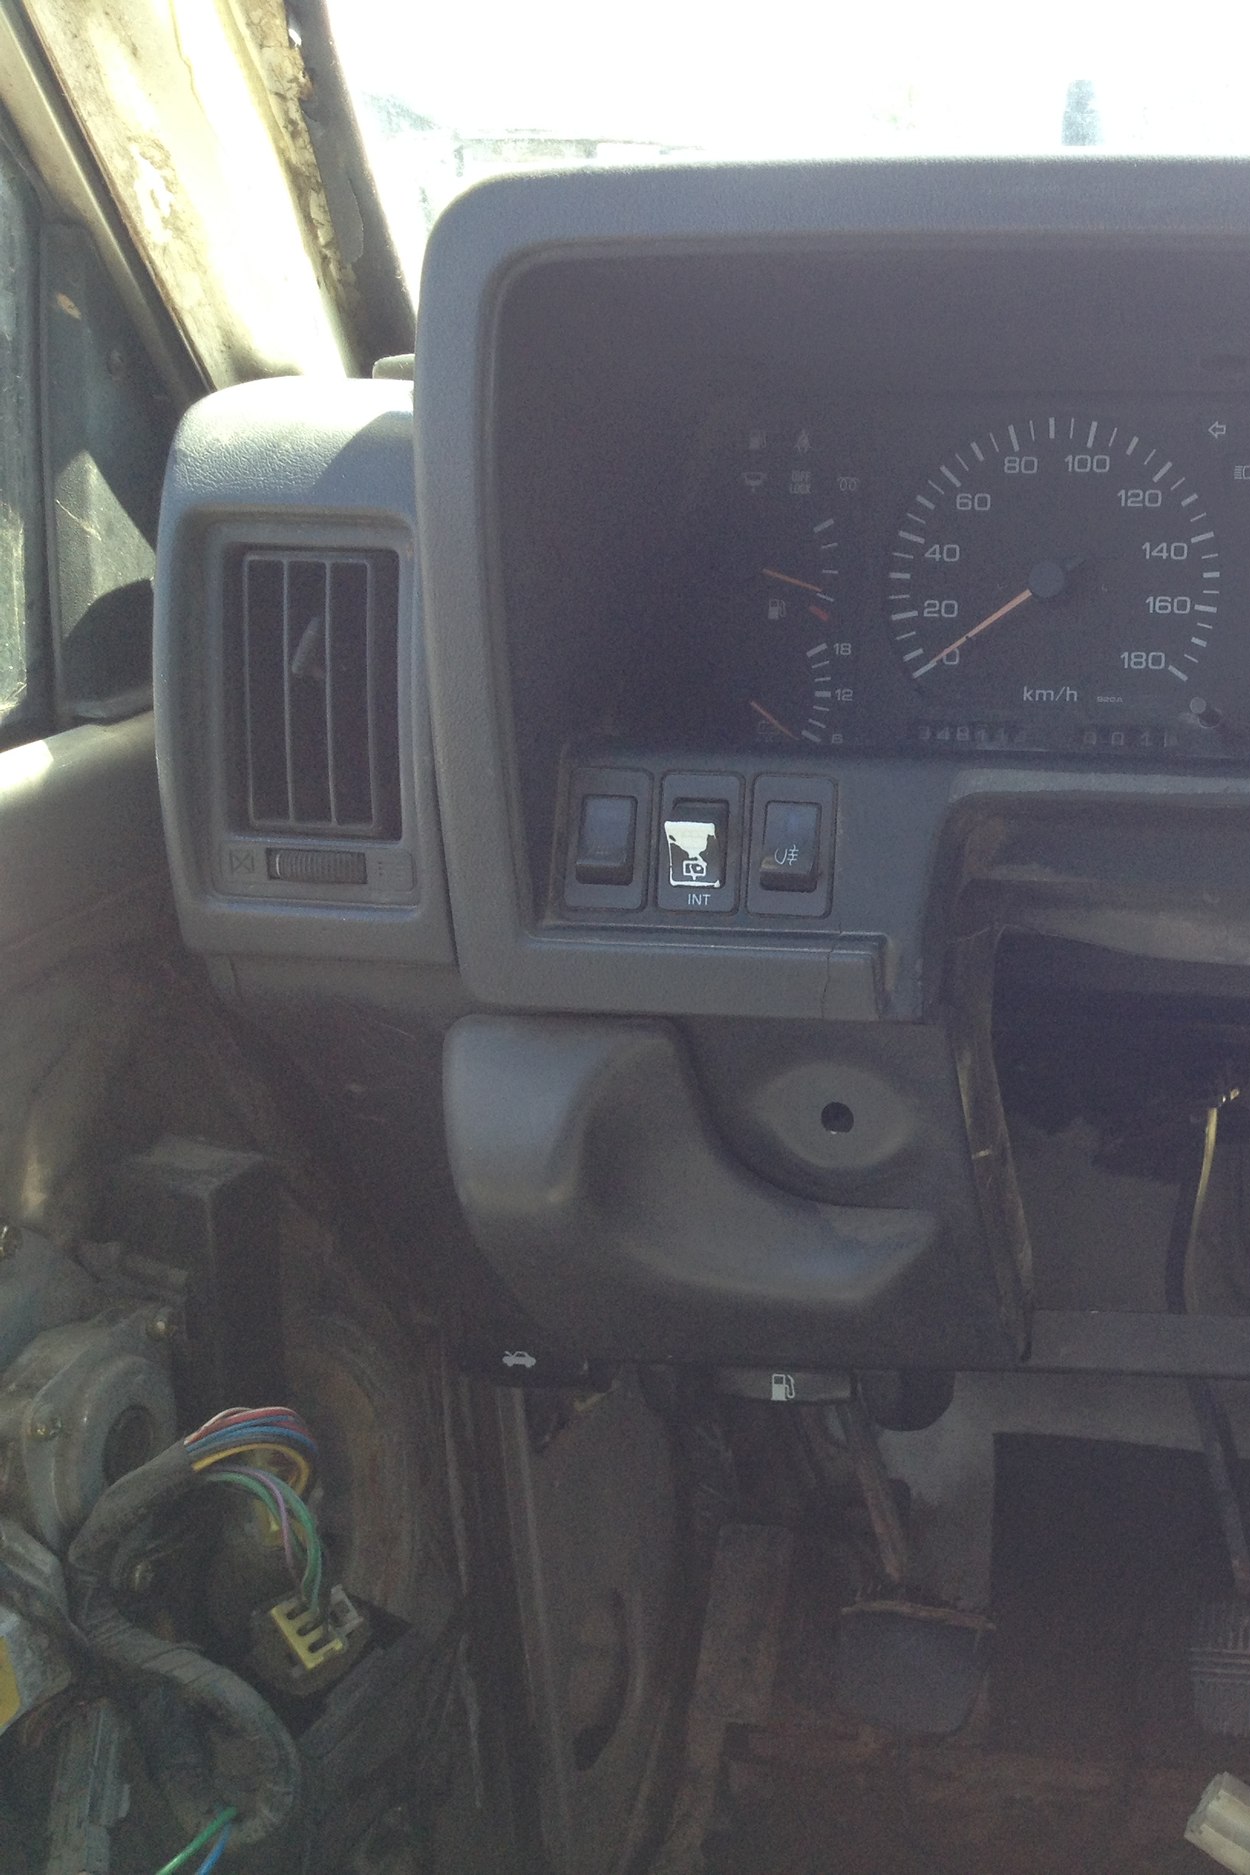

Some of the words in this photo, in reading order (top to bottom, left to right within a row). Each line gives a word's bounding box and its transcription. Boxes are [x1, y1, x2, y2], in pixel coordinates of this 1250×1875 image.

[1003, 455, 1038, 475] 80
[1064, 454, 1110, 473] 100
[955, 493, 991, 511] 60
[1116, 489, 1163, 508] 120
[924, 544, 960, 563] 40
[1142, 541, 1188, 560] 140
[923, 600, 958, 618] 20
[1145, 597, 1191, 615] 160
[1119, 651, 1166, 670] 180
[834, 688, 854, 702] 12
[1022, 685, 1078, 703] km/h
[687, 893, 711, 906] INT
